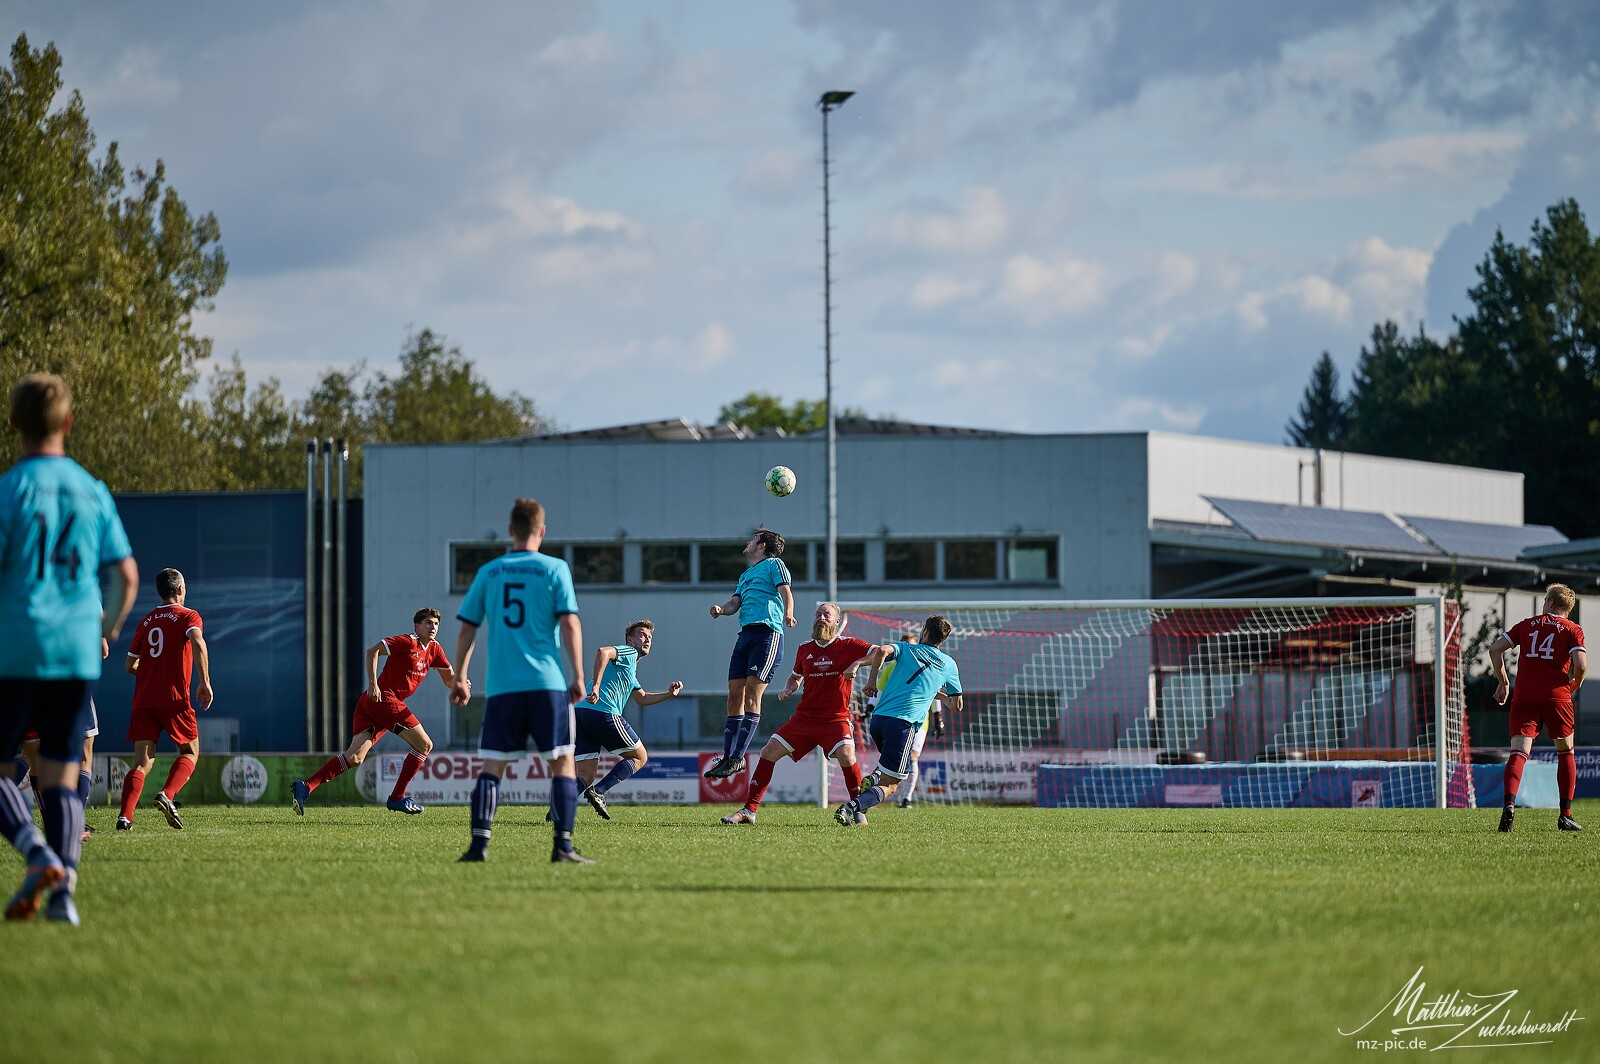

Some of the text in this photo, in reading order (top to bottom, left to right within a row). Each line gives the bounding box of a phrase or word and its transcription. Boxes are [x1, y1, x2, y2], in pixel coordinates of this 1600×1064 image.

[33, 511, 83, 580] 14
[154, 611, 178, 623] Laufen
[502, 582, 525, 628] 5
[147, 626, 164, 658] 9
[1525, 629, 1556, 660] 14
[905, 657, 932, 685] 7
[950, 760, 1017, 774] Volksbank
[673, 790, 685, 801] 22
